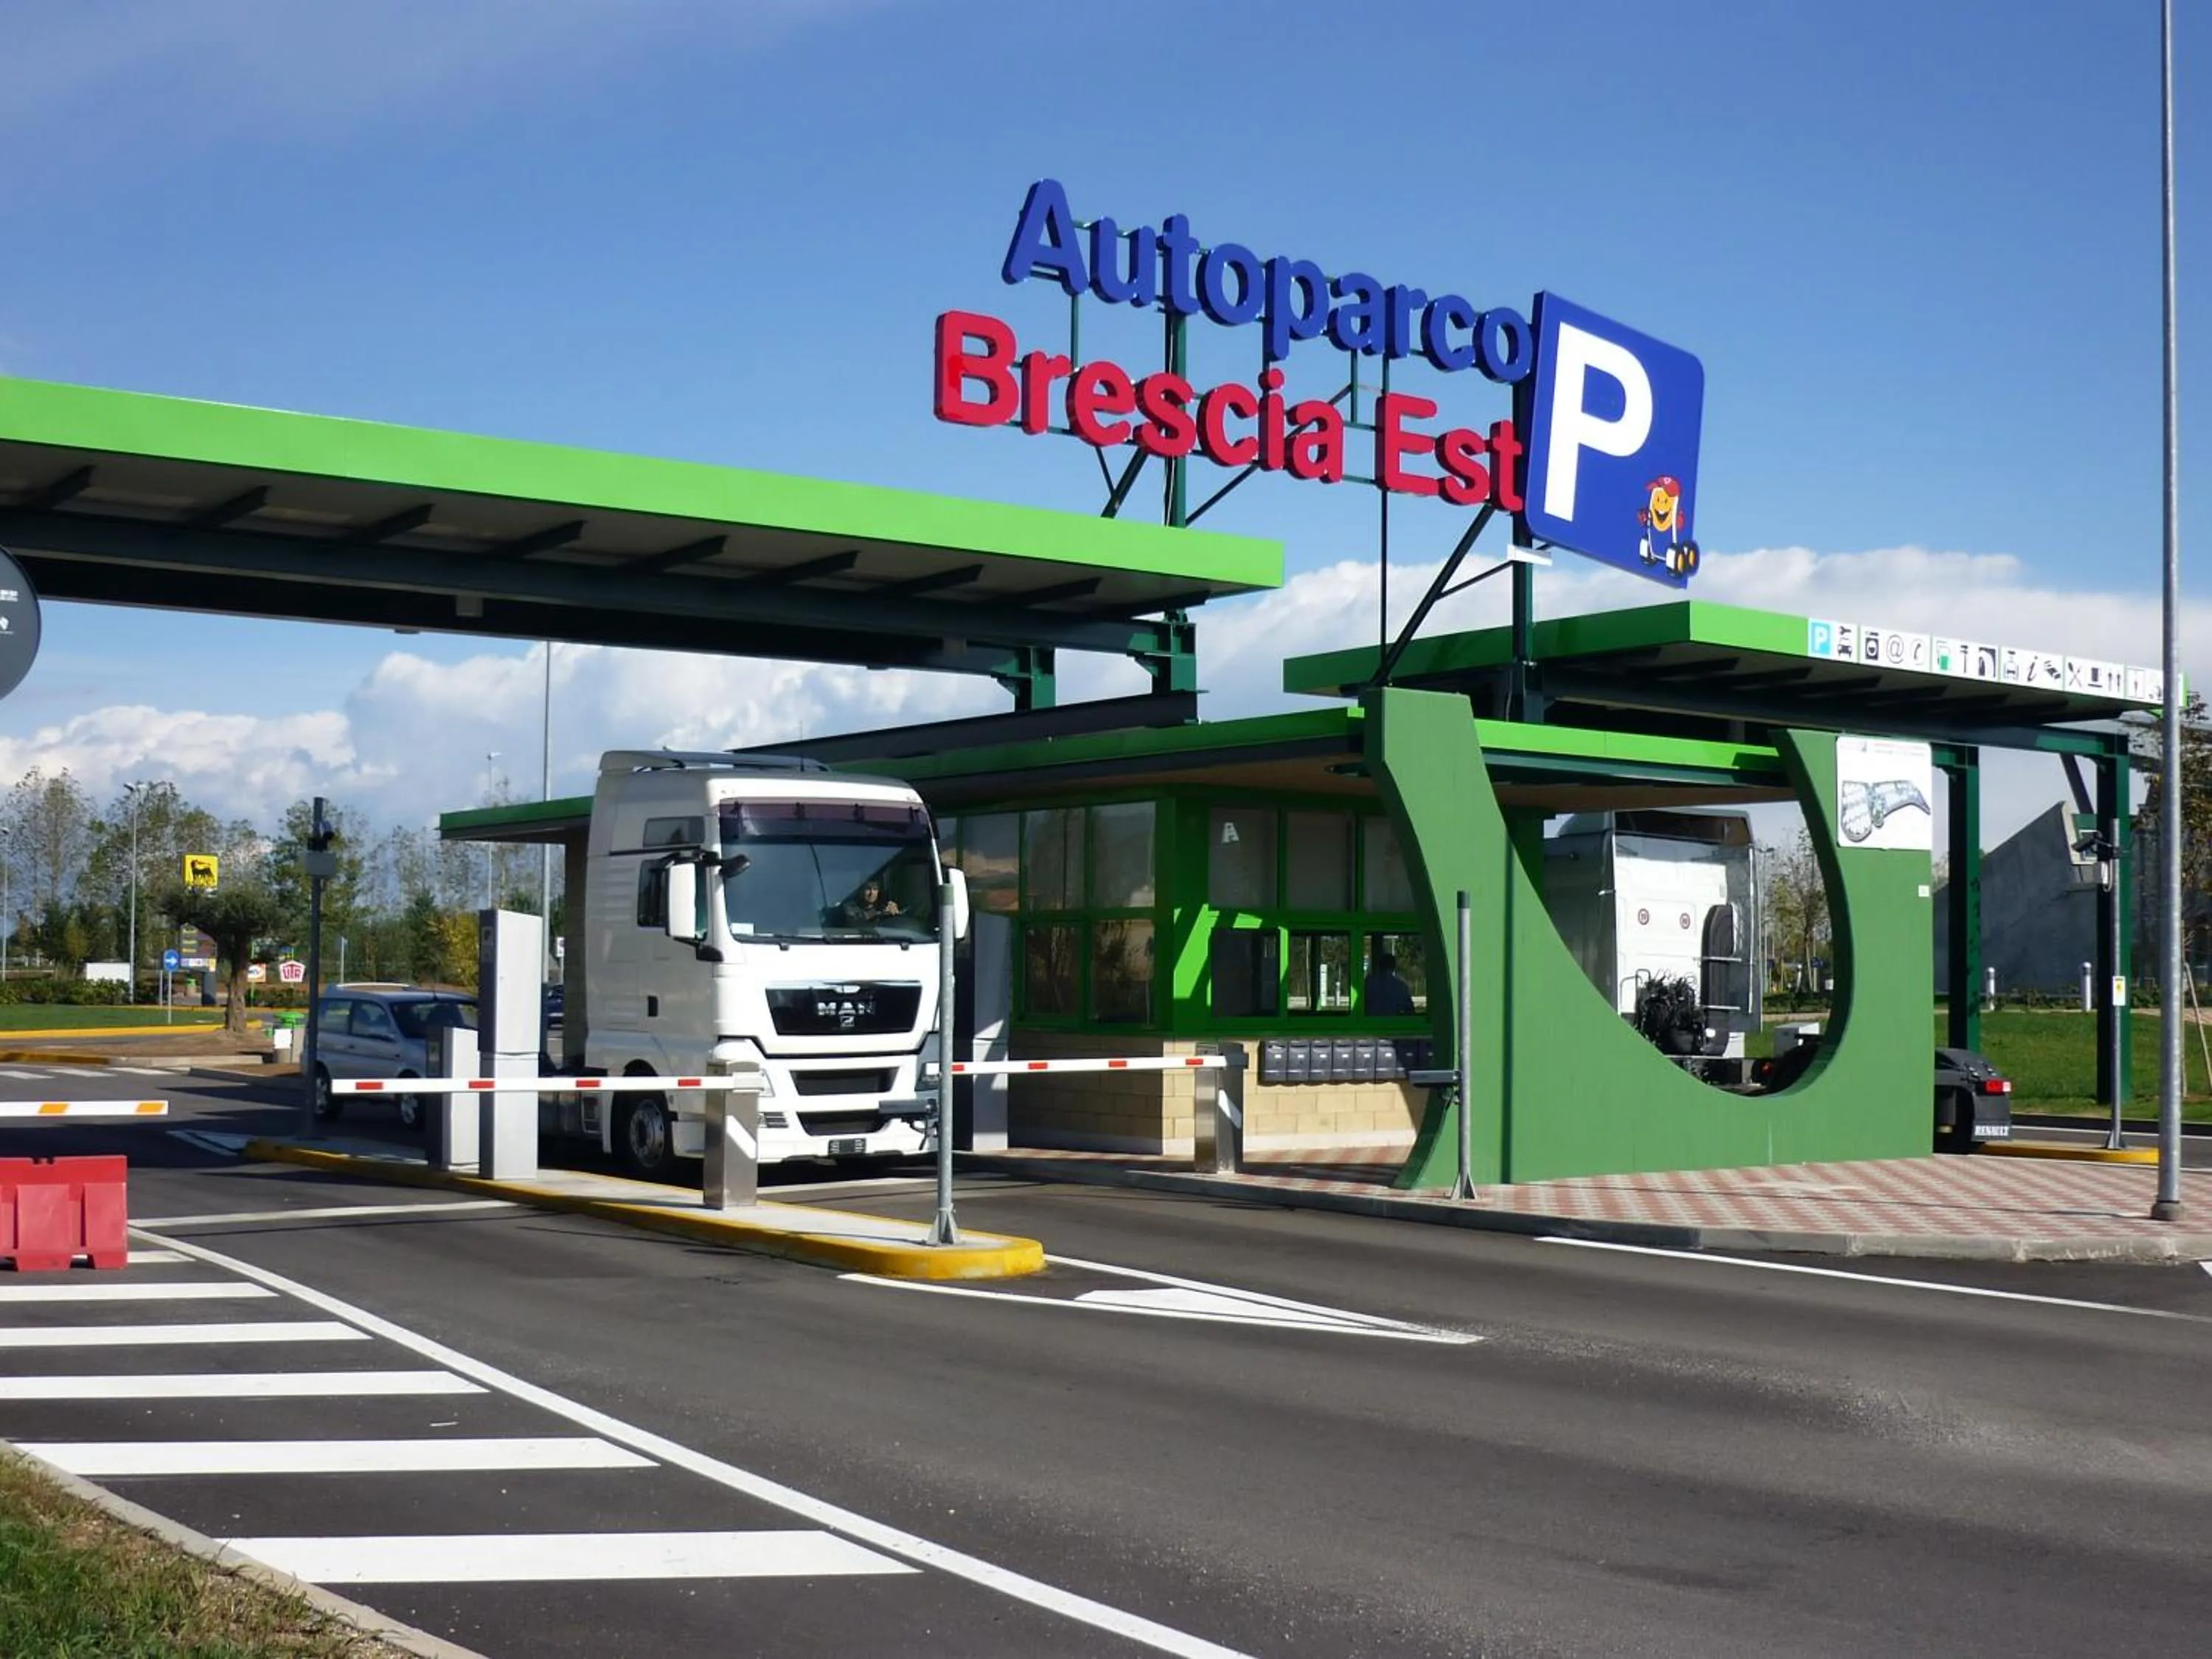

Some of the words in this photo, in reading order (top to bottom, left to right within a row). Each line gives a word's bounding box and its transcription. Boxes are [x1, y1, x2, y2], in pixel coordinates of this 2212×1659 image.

[1001, 178, 1534, 383] Autoparco
[933, 310, 1344, 483] Brescia
[1374, 392, 1523, 512] Est
[1544, 321, 1653, 522] P
[818, 1002, 874, 1015] MAN
